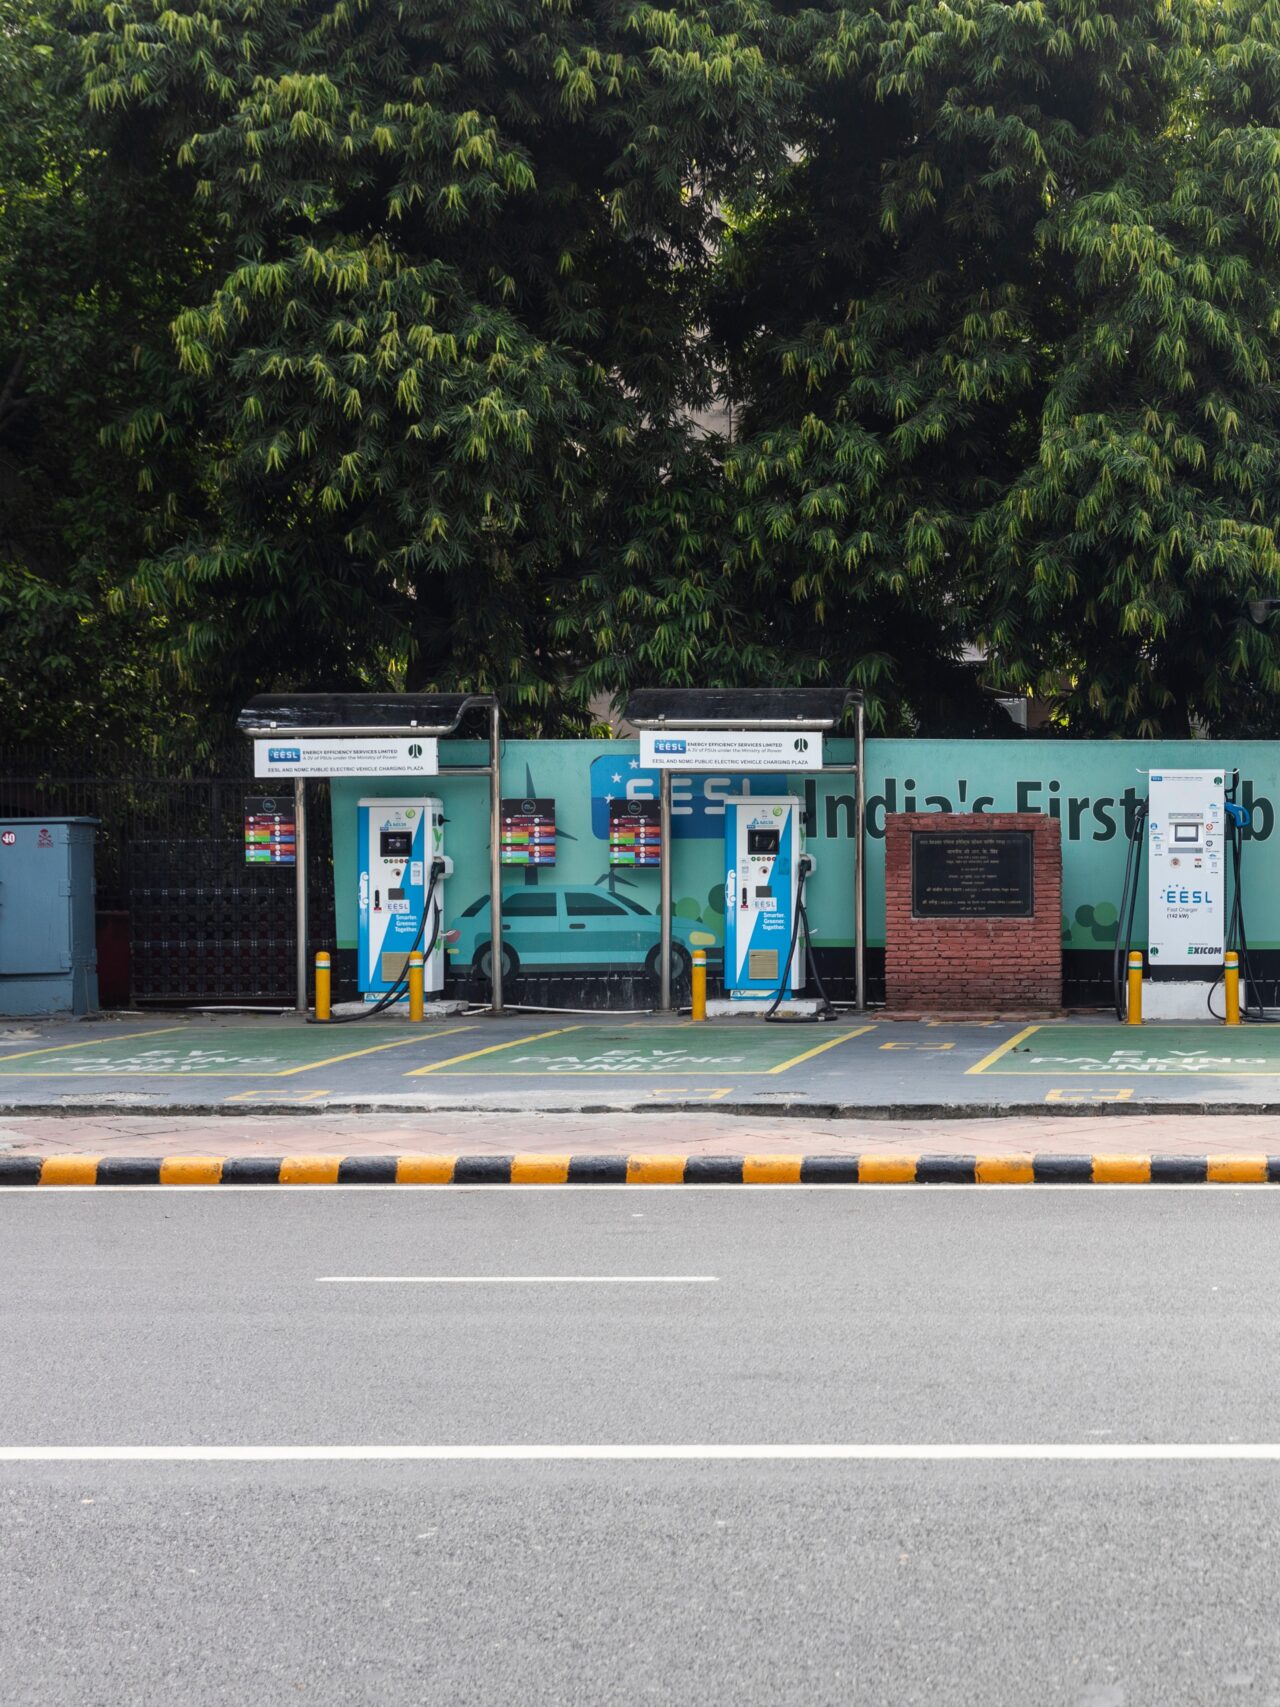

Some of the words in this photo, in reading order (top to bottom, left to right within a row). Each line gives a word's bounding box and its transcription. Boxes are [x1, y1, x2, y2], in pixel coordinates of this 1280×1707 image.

[659, 743, 683, 751] EESL
[273, 751, 298, 759] EESL
[1167, 891, 1212, 903] EESL
